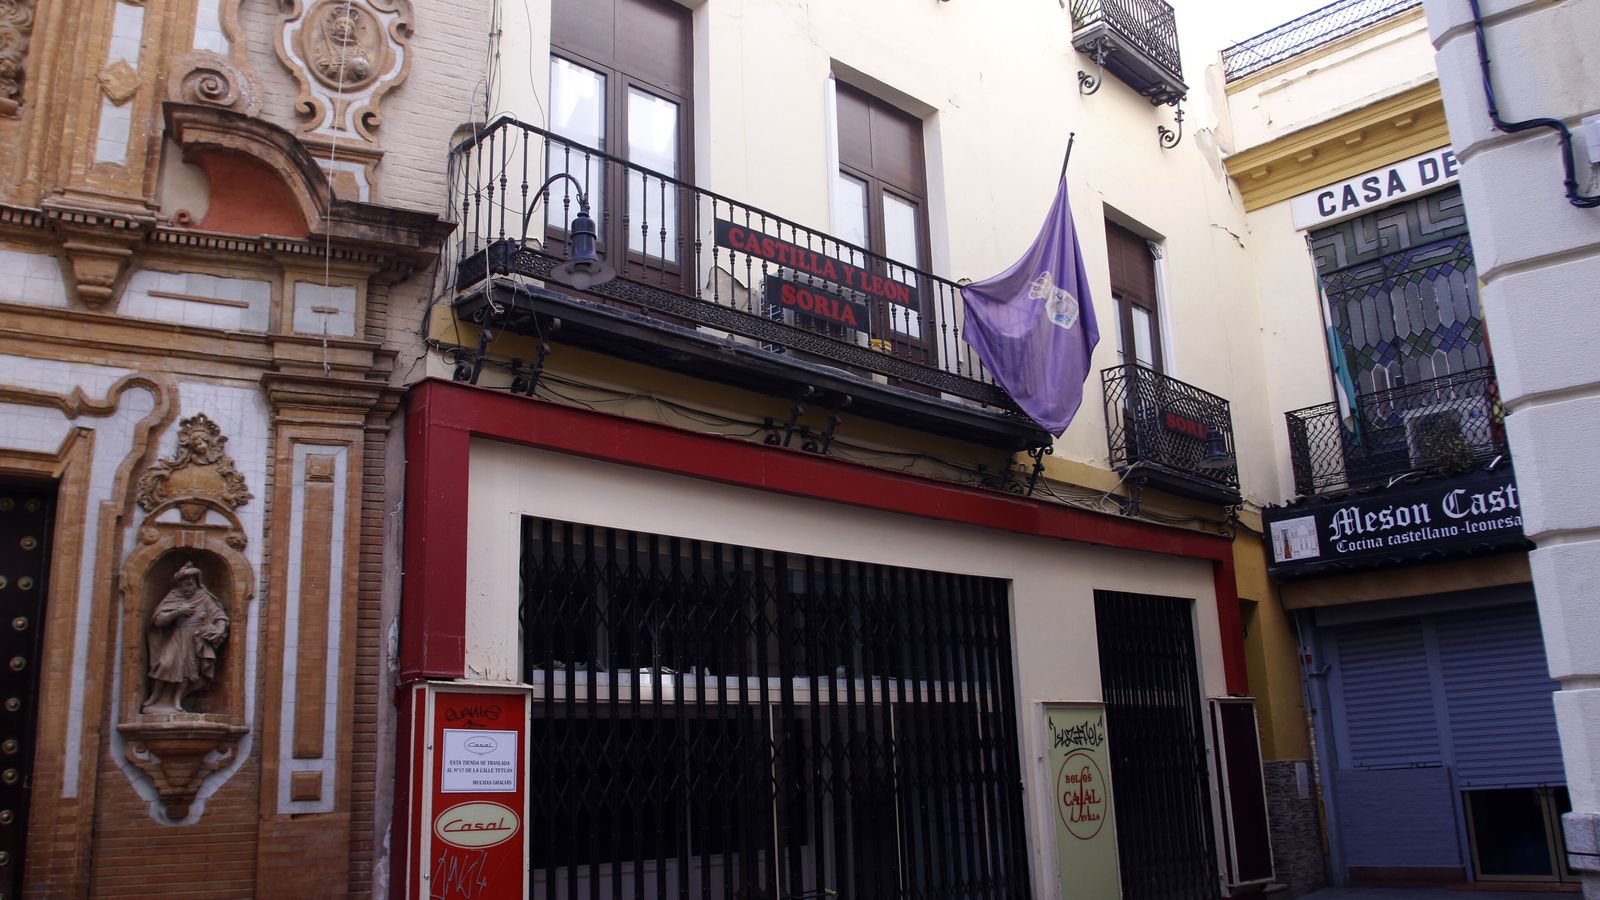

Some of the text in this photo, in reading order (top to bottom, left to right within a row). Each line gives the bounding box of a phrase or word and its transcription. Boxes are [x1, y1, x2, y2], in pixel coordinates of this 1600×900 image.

[1317, 150, 1459, 217] CASA DE
[728, 227, 838, 280] CASTILLA
[842, 263, 856, 286] Y
[780, 283, 857, 326] SORIA
[1329, 483, 1519, 542] Meson Cast
[1336, 537, 1383, 553] Cocina
[443, 816, 512, 833] Casal
